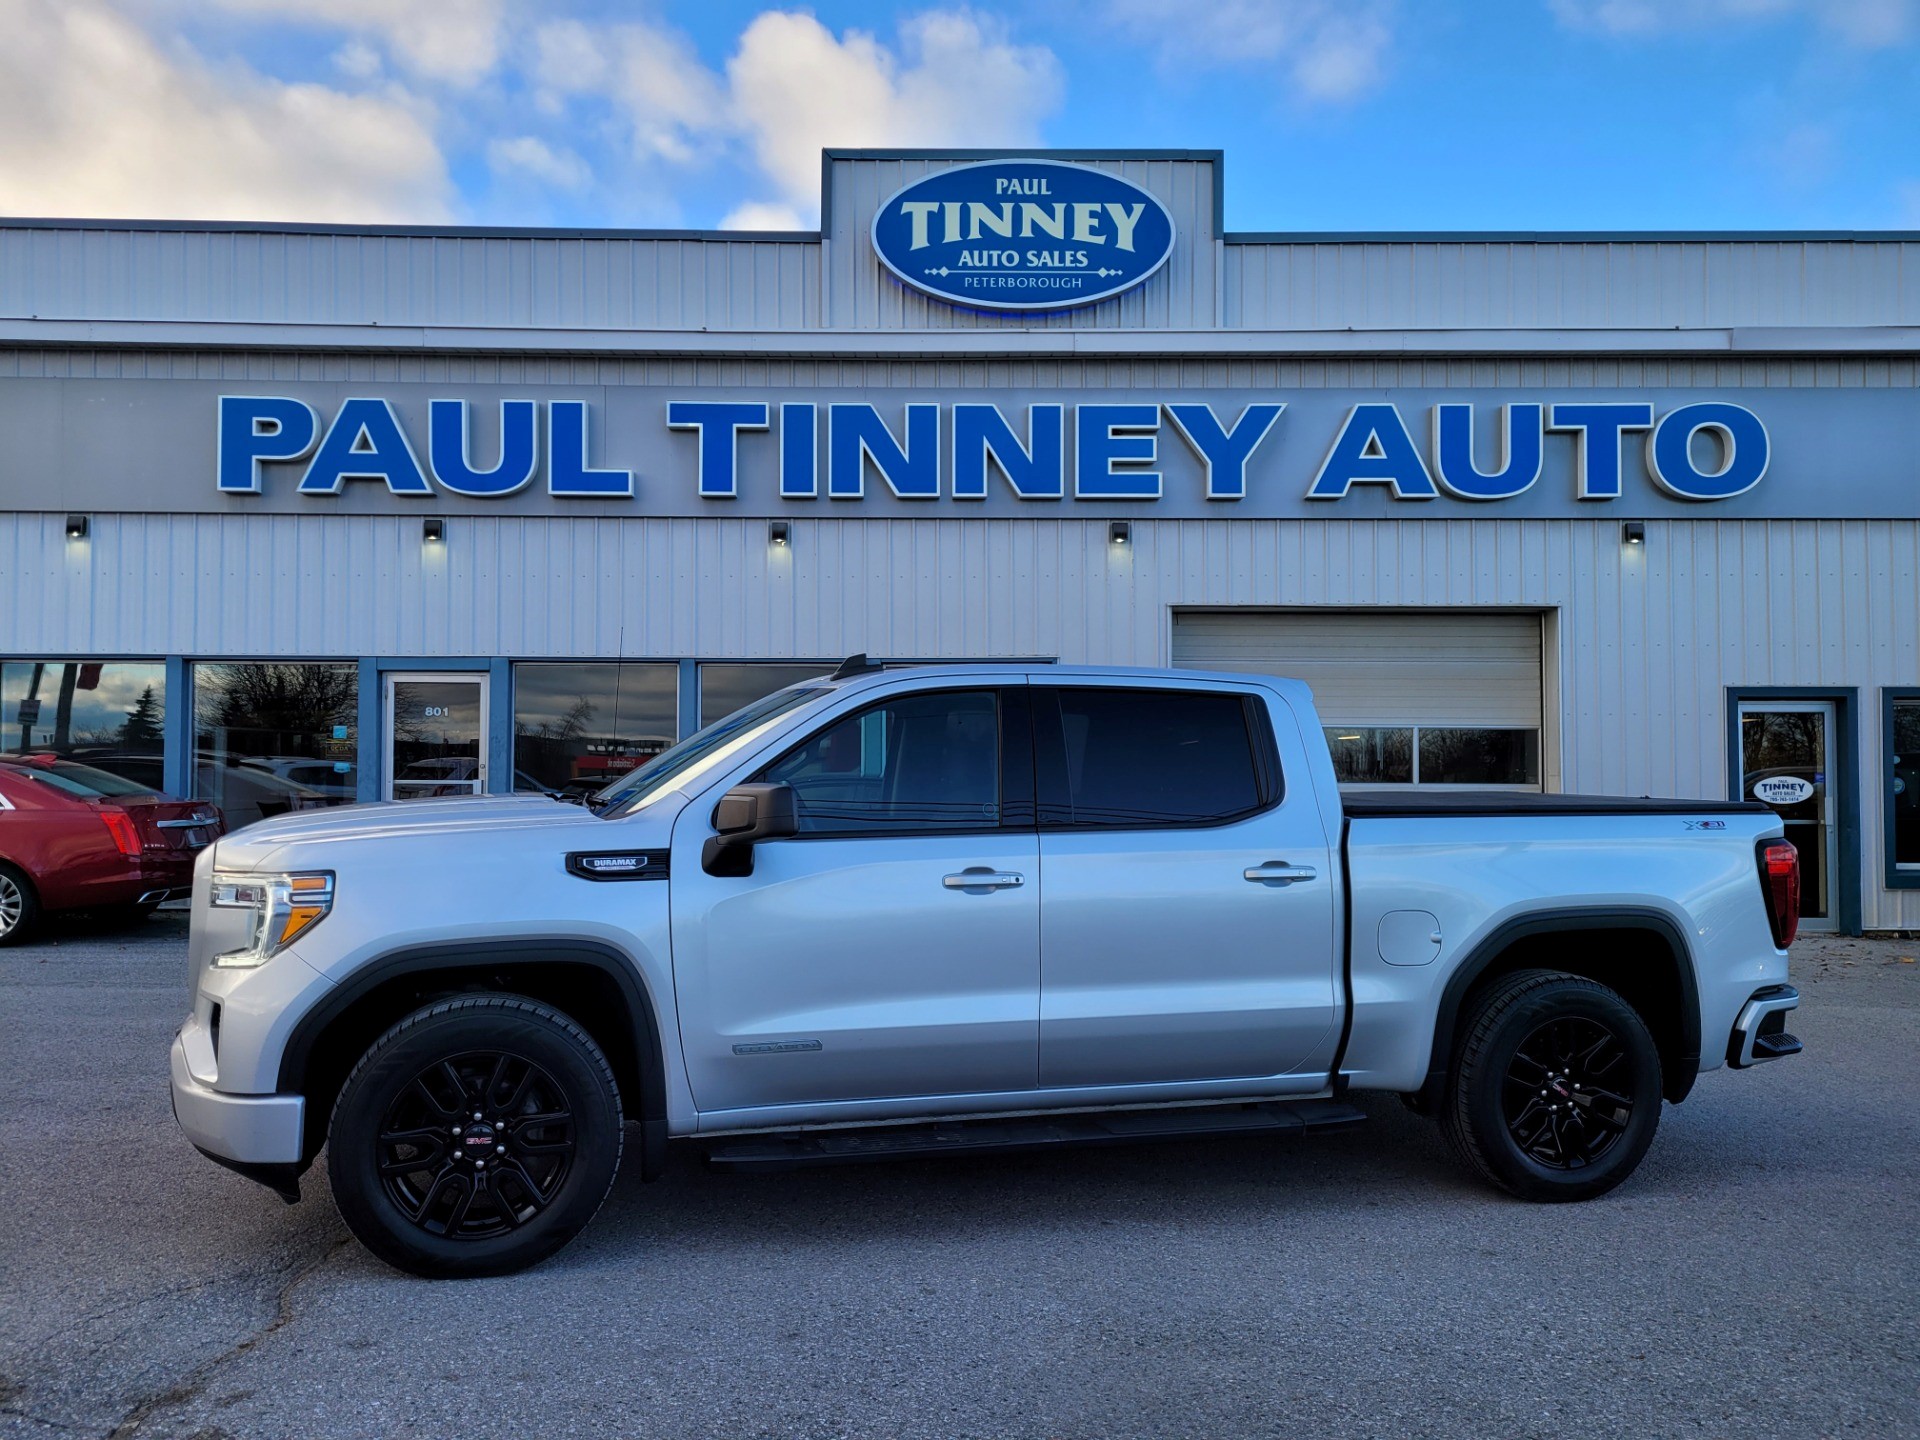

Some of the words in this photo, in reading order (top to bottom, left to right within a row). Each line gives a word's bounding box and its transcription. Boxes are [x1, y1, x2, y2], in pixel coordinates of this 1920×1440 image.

[995, 178, 1052, 195] PAUL
[901, 201, 1147, 252] TINNEY
[958, 250, 1020, 267] AUTO
[1026, 250, 1089, 267] SALES
[964, 277, 1082, 289] PETERBOROUGH
[217, 395, 636, 497] PAUL
[666, 401, 1288, 500] TINNEY
[1304, 401, 1771, 500] AUTO
[425, 706, 449, 717] 801
[1761, 783, 1805, 793] TINNEY
[594, 858, 637, 867] DURAMAX
[466, 1136, 493, 1145] GMC
